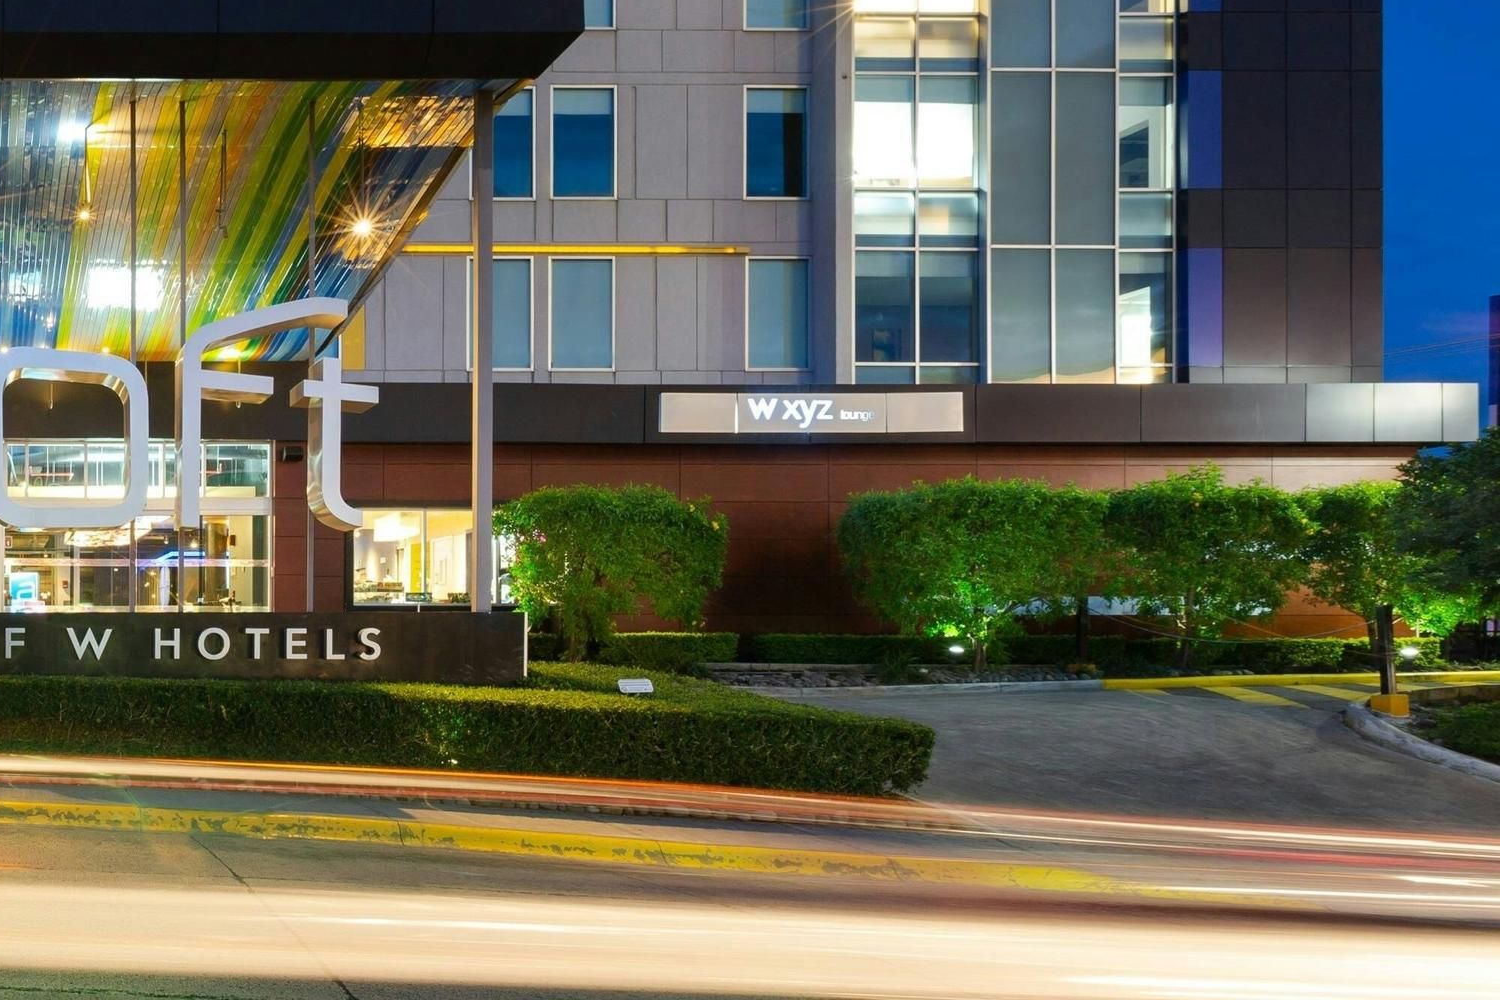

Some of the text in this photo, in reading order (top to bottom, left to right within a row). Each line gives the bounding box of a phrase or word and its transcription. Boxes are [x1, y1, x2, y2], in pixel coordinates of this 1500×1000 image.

[781, 399, 834, 428] xyz
[66, 627, 113, 660] W
[154, 627, 382, 661] HOTELS
